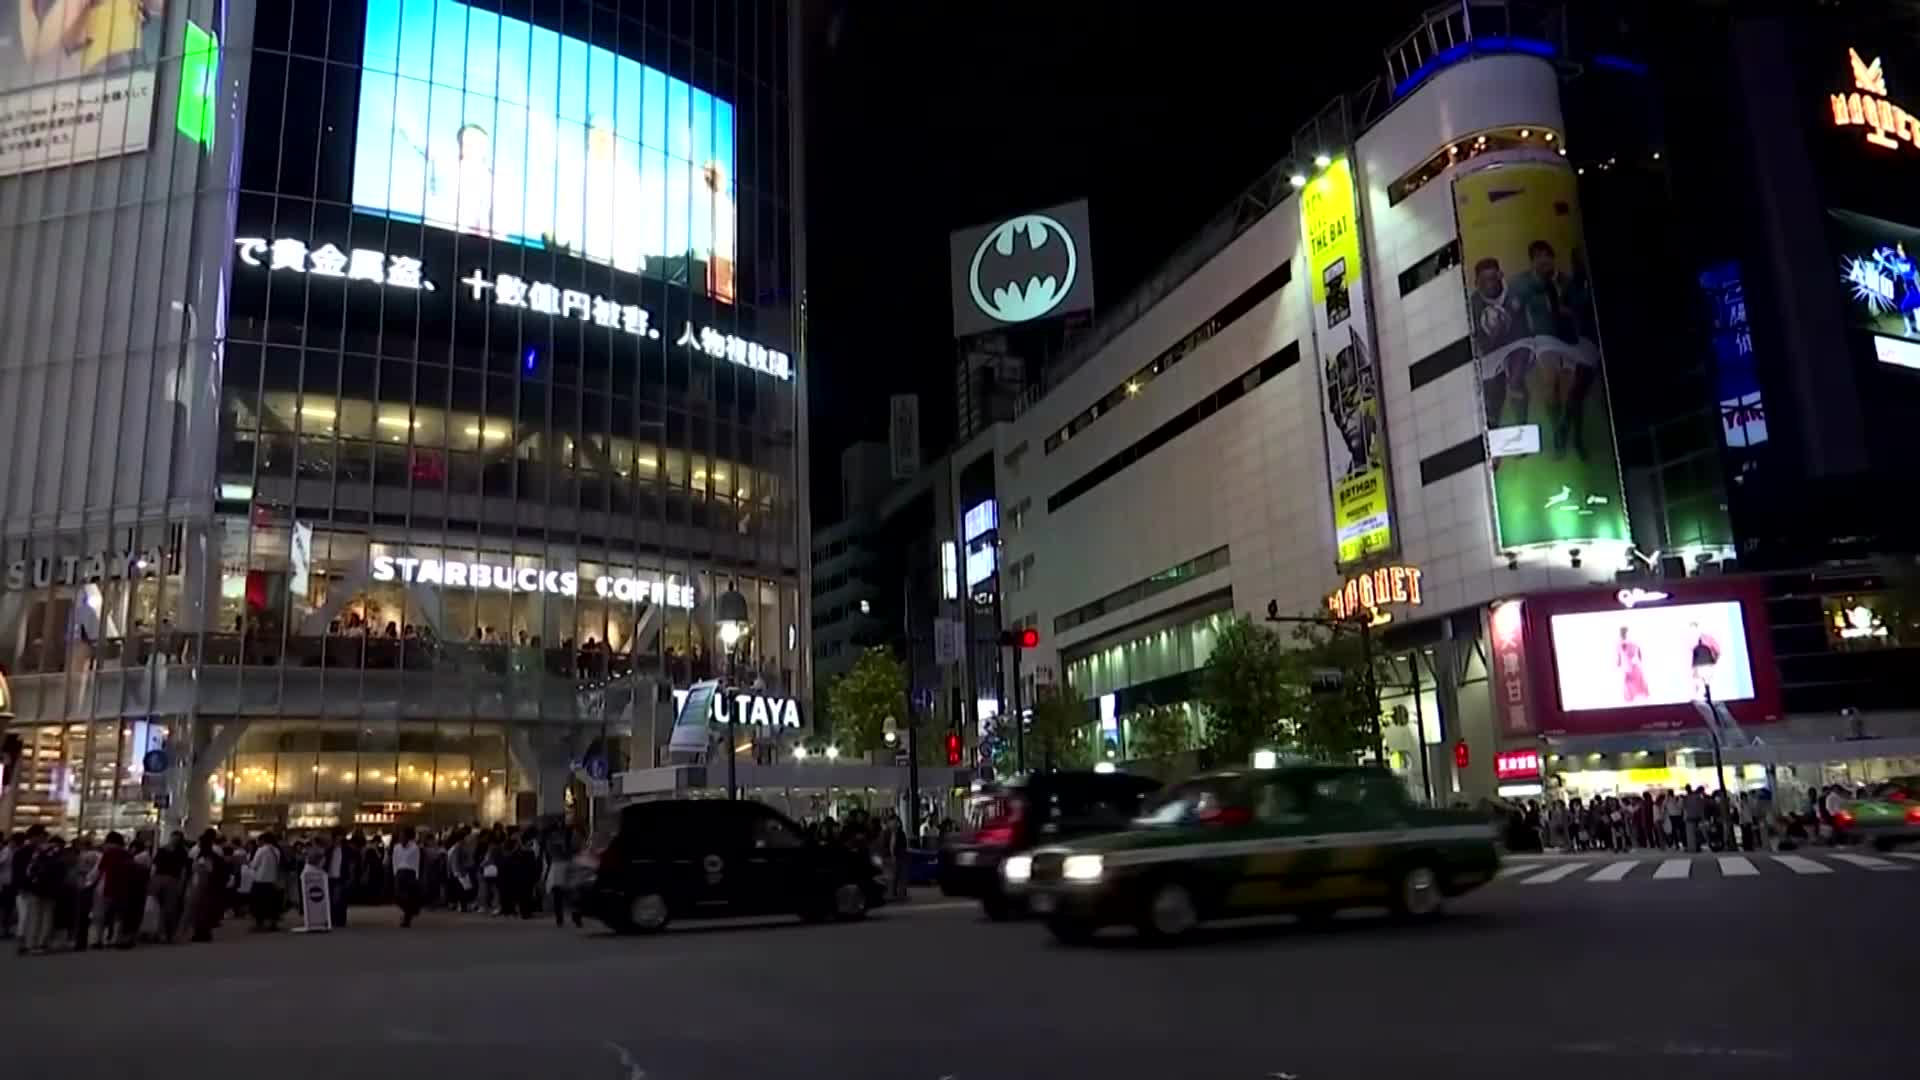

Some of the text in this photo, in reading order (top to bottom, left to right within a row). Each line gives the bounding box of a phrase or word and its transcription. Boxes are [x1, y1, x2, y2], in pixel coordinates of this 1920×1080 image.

[1311, 230, 1328, 256] THE
[1329, 215, 1348, 243] BAT
[373, 556, 695, 609] STARBUCKS COFFEE
[672, 689, 800, 728] TUTAYA
